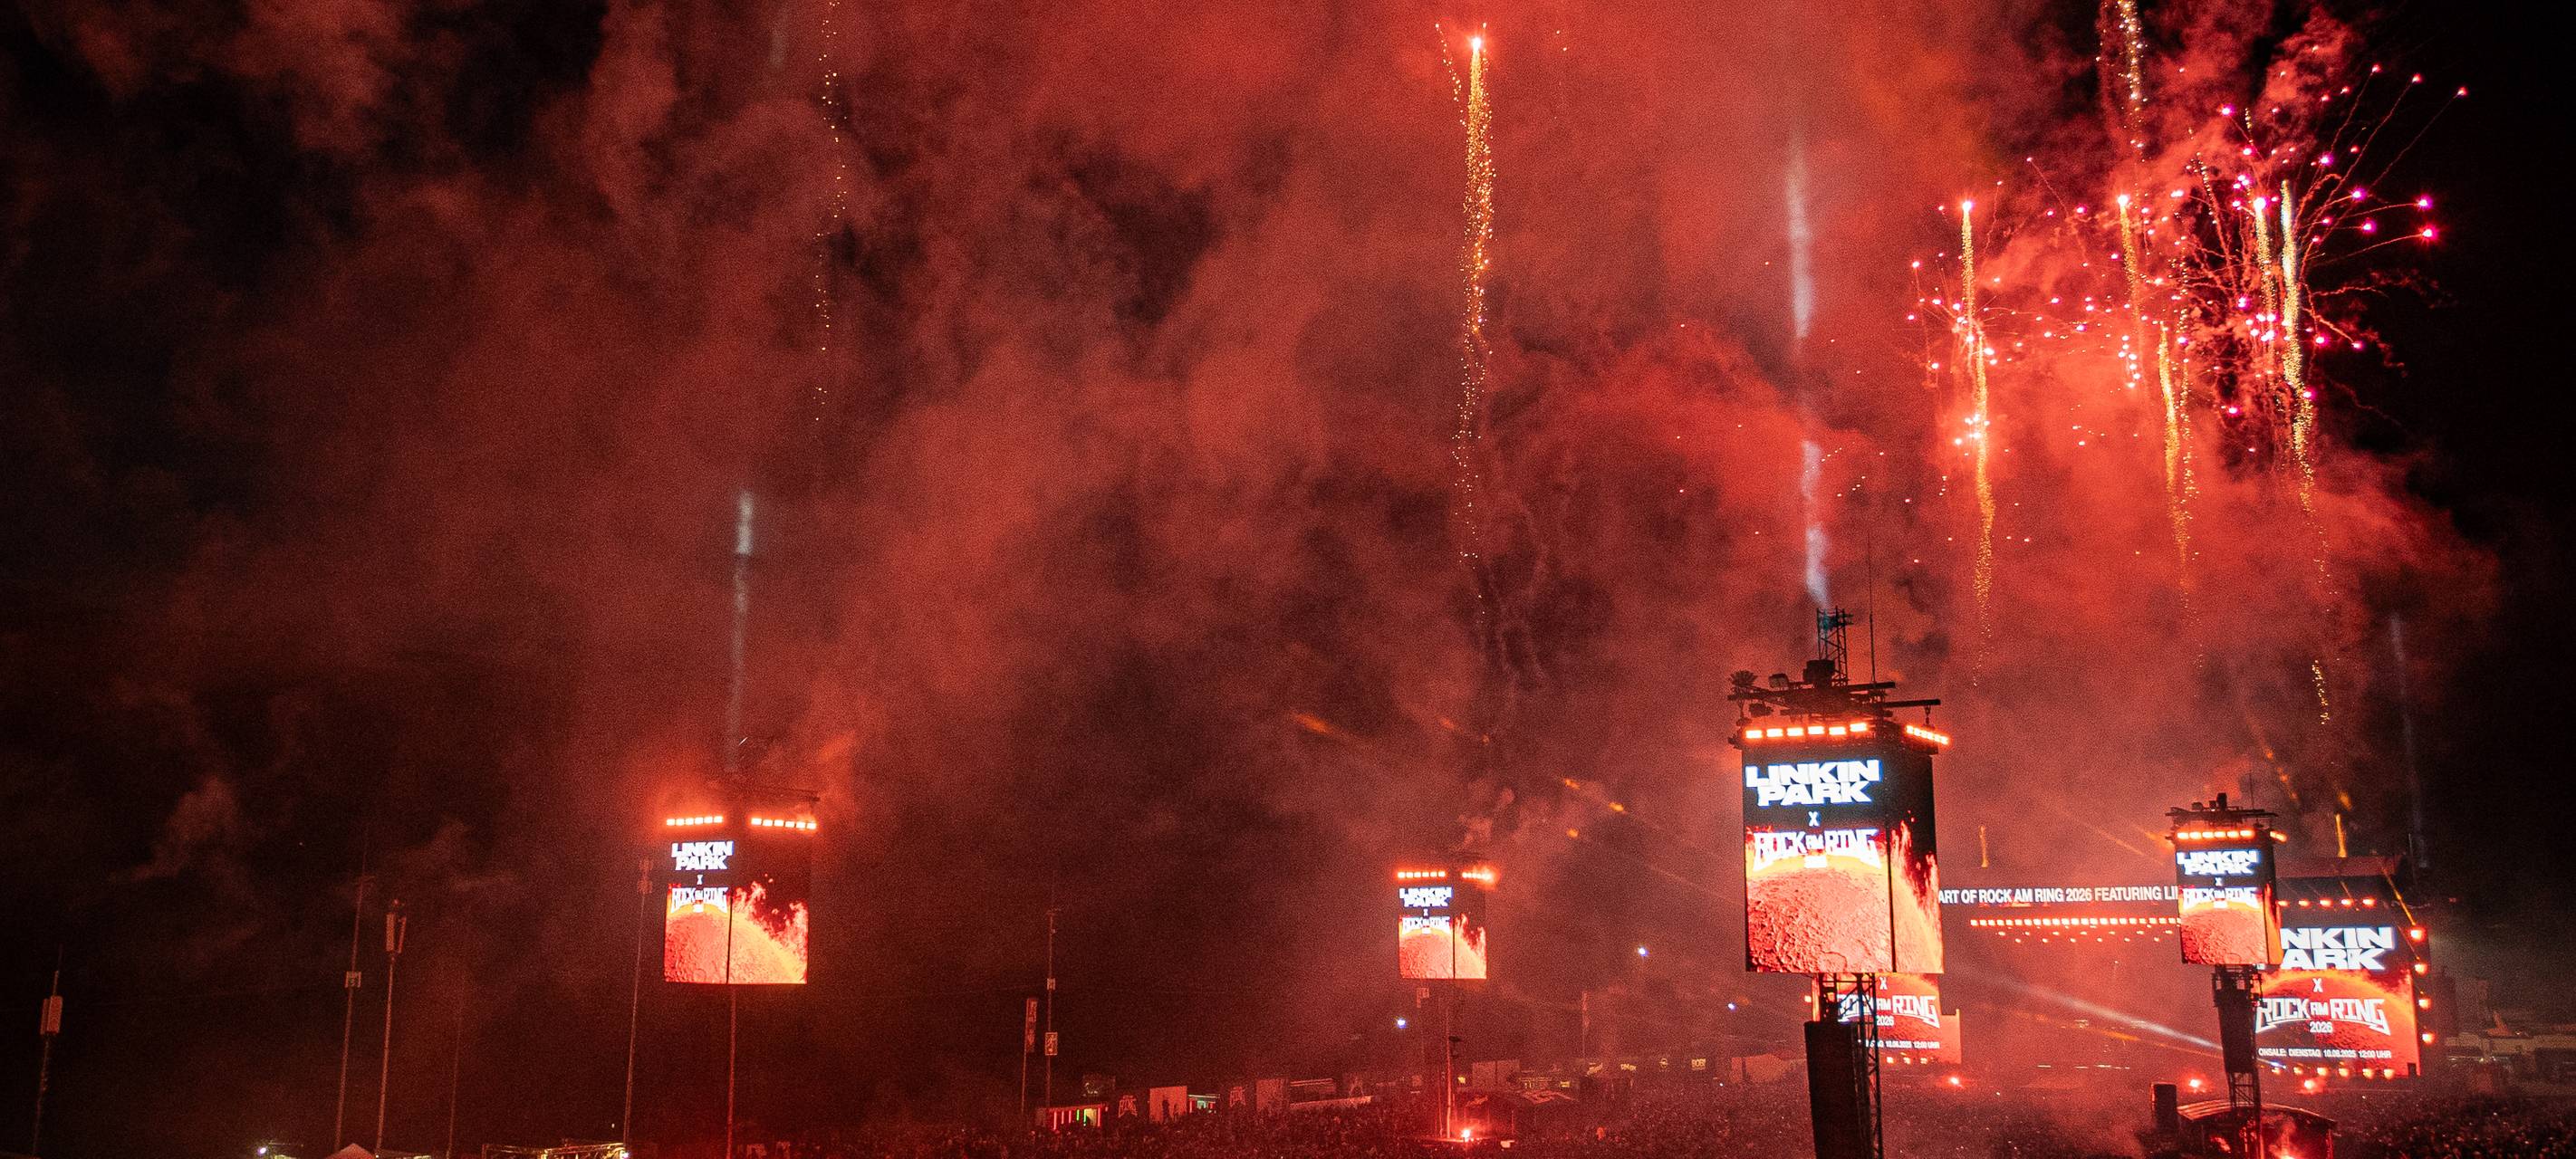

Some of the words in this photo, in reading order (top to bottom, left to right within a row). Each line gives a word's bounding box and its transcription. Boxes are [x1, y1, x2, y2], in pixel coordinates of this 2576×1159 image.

[1745, 760, 1879, 787] LINKIN
[1757, 781, 1872, 806] PARK
[671, 841, 734, 857] LINKIN
[1753, 831, 1808, 871] ROCK
[1823, 829, 1881, 869] RING
[675, 856, 727, 870] PARK
[2176, 850, 2258, 865] LINKIN
[2184, 862, 2254, 876] PARK
[1937, 889, 1959, 904] ART
[1961, 889, 1977, 904] OF
[1978, 888, 2013, 904] ROCK
[2014, 888, 2033, 903] AM
[2034, 887, 2065, 903] RING
[2065, 887, 2093, 902] 2026
[2093, 886, 2162, 902] FEATURING
[2279, 926, 2395, 950] NKIN
[2279, 948, 2385, 971] ARK
[1879, 977, 1888, 991] X
[2312, 978, 2323, 993] X
[1892, 995, 1940, 1029] RING
[2255, 998, 2311, 1034] ROCK
[2330, 998, 2391, 1036] RING
[1877, 1015, 1895, 1026] 2026
[2310, 1021, 2333, 1033] 2026
[2288, 1048, 2322, 1058] DIENSTAG
[2358, 1049, 2376, 1058] 12:00
[2376, 1049, 2392, 1059] UHR
